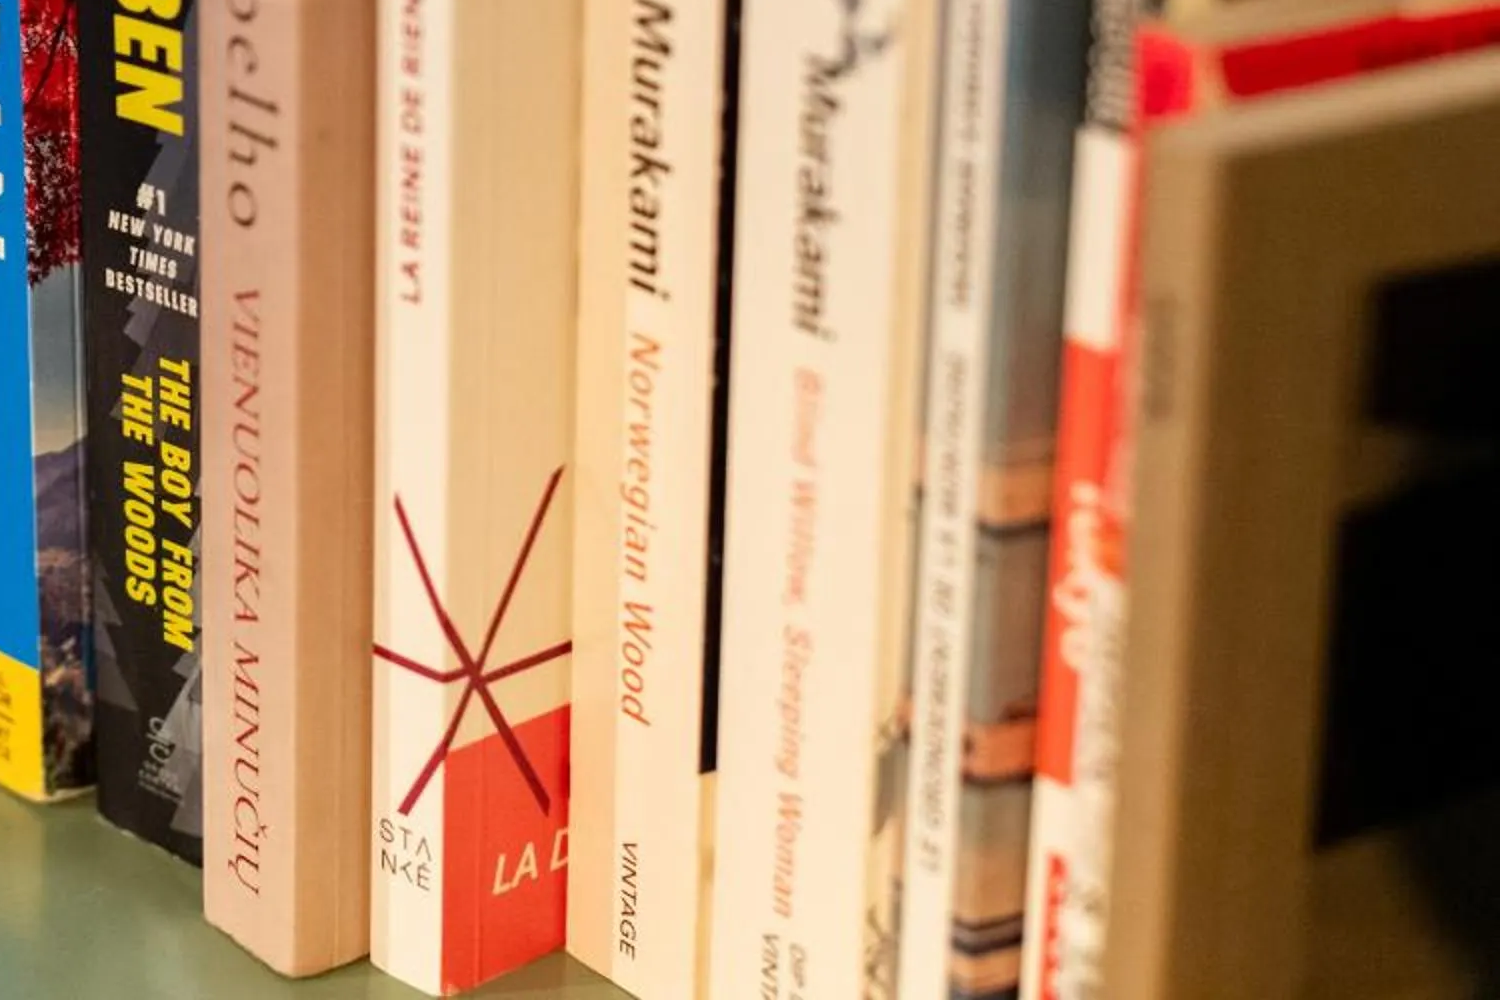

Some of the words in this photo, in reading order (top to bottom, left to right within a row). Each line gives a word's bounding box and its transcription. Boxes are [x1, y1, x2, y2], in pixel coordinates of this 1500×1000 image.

[399, 85, 423, 135] DE
[107, 208, 147, 239] NEW
[152, 222, 197, 258] YORK
[136, 181, 167, 217] #1
[791, 53, 842, 343] Murakami
[104, 266, 199, 319] BESTSELLER
[129, 245, 178, 280] TIMES
[399, 259, 423, 306] LA
[120, 372, 155, 446] THE
[158, 356, 192, 431] THE
[159, 441, 193, 529] BOY
[229, 286, 263, 627] VIENUOLIKA
[619, 330, 662, 584] Norwegian
[122, 460, 158, 607] WOODS
[160, 536, 195, 653] FROM
[618, 596, 656, 727] Wood
[772, 623, 815, 780] Sleeping
[226, 634, 271, 897] MINUČIŲ
[491, 840, 539, 896] LA
[618, 839, 638, 961] VINTAGE
[770, 792, 807, 921] Woman
